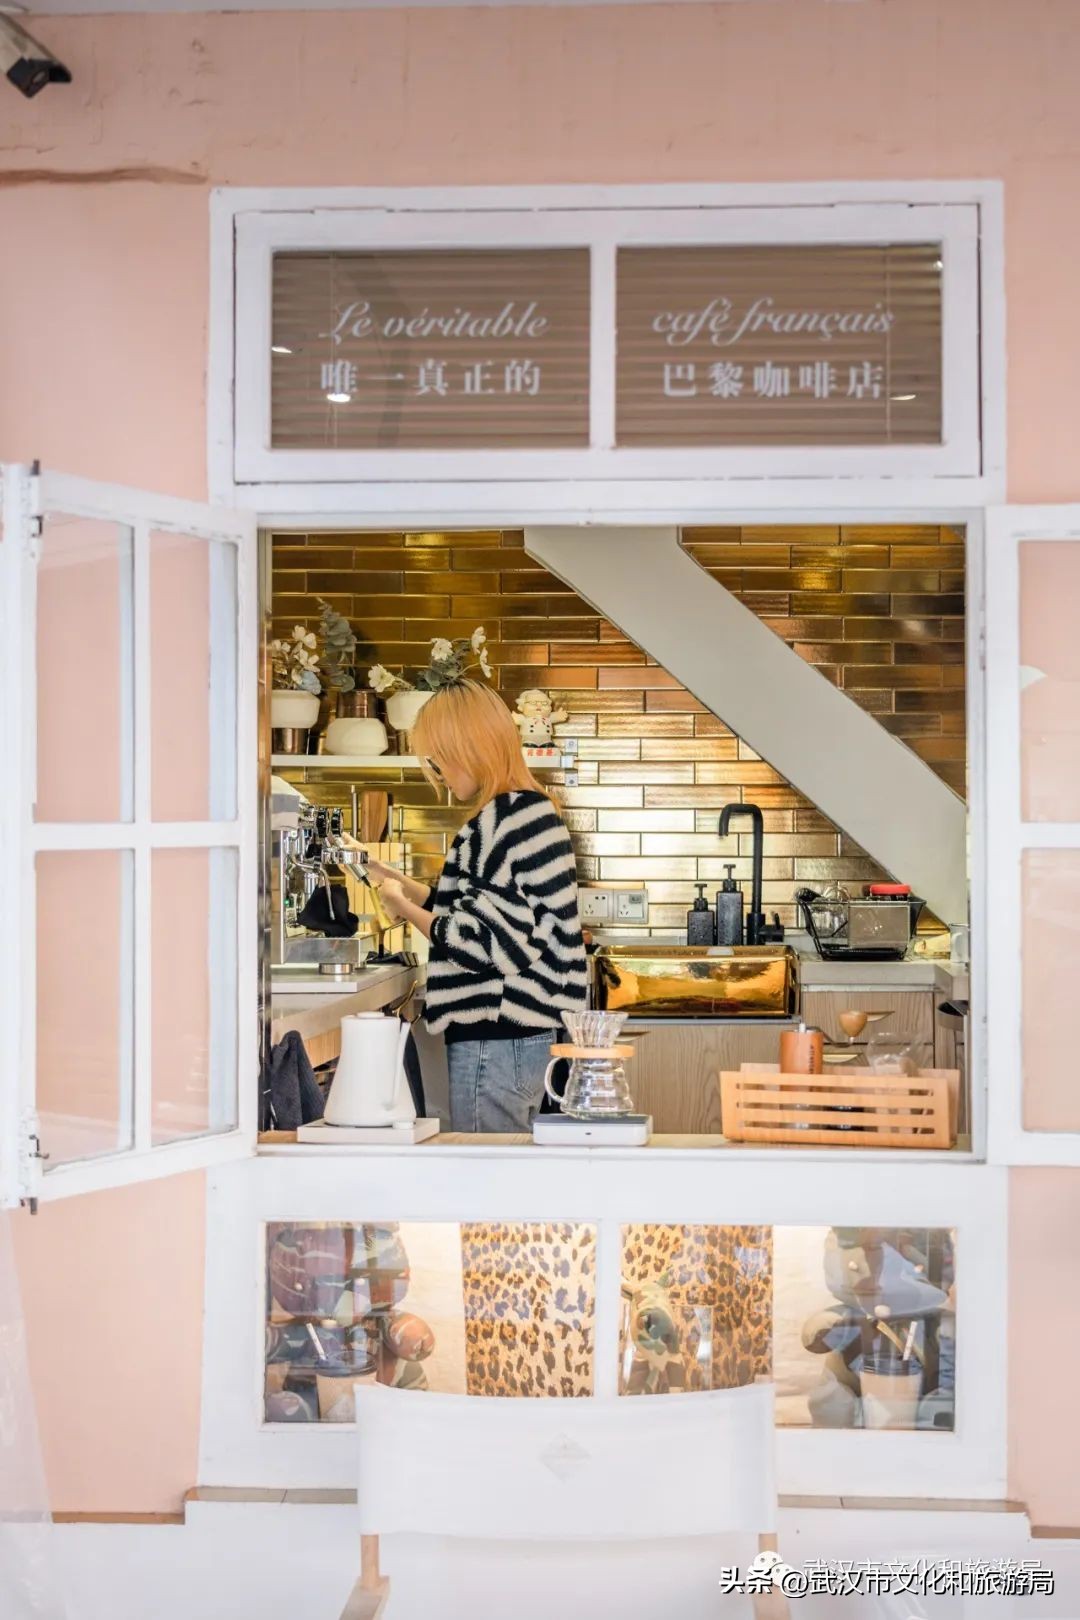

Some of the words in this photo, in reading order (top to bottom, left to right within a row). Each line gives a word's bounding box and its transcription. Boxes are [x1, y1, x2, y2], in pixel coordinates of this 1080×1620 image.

[318, 302, 371, 345] Le
[383, 302, 548, 338] véritable
[653, 298, 732, 346] café
[711, 298, 894, 346] français
[321, 359, 541, 396] 唯一真正的
[663, 361, 884, 399] 巴黎咖啡店
